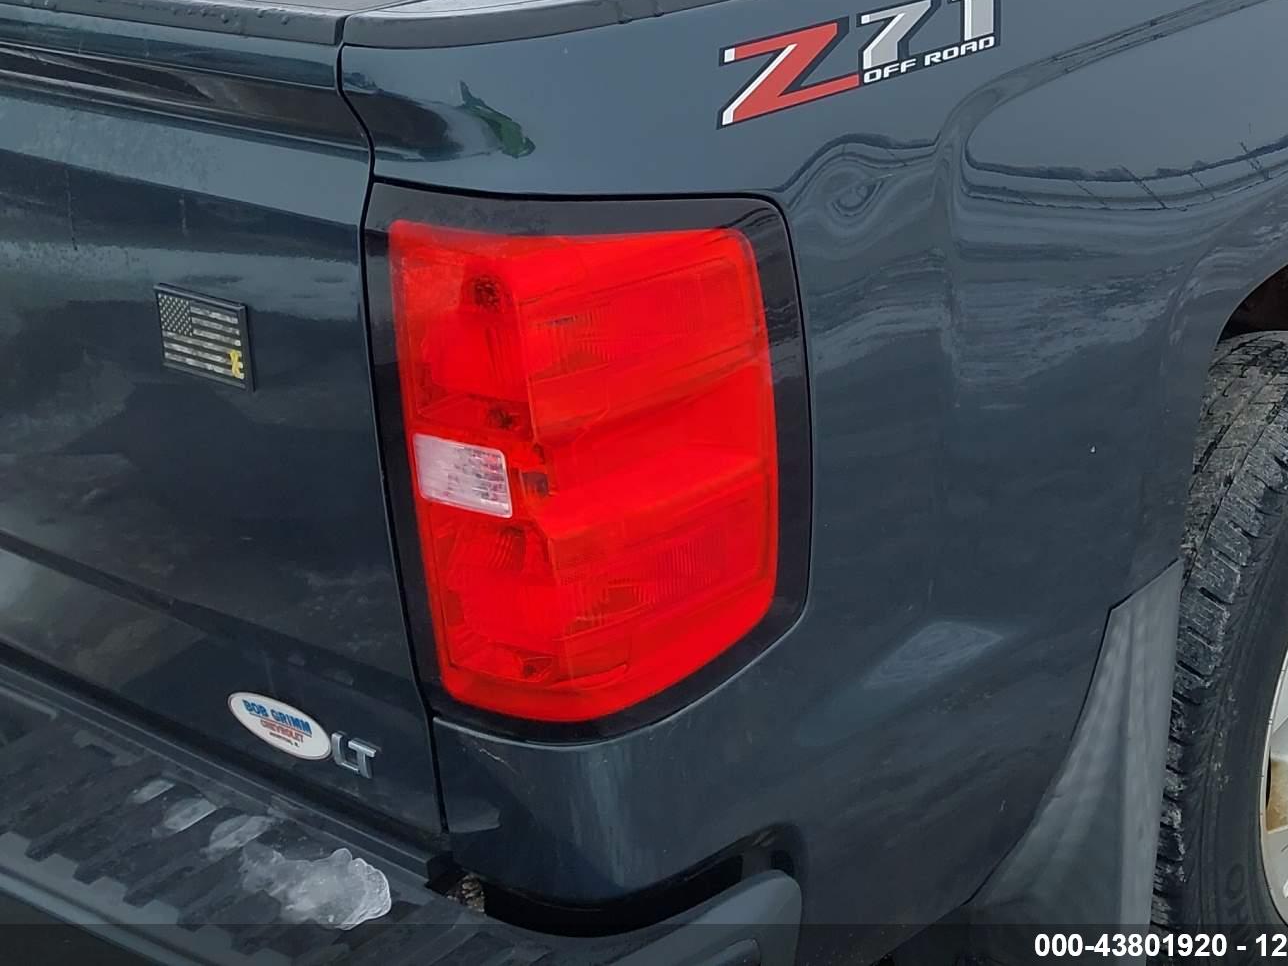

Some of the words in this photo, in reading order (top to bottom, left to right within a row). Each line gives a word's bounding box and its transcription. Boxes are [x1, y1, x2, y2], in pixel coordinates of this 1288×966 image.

[863, 58, 916, 84] OFF
[924, 36, 995, 66] ROAD
[242, 699, 269, 718] BOB
[270, 708, 313, 735] GRIMM
[332, 731, 378, 779] LT
